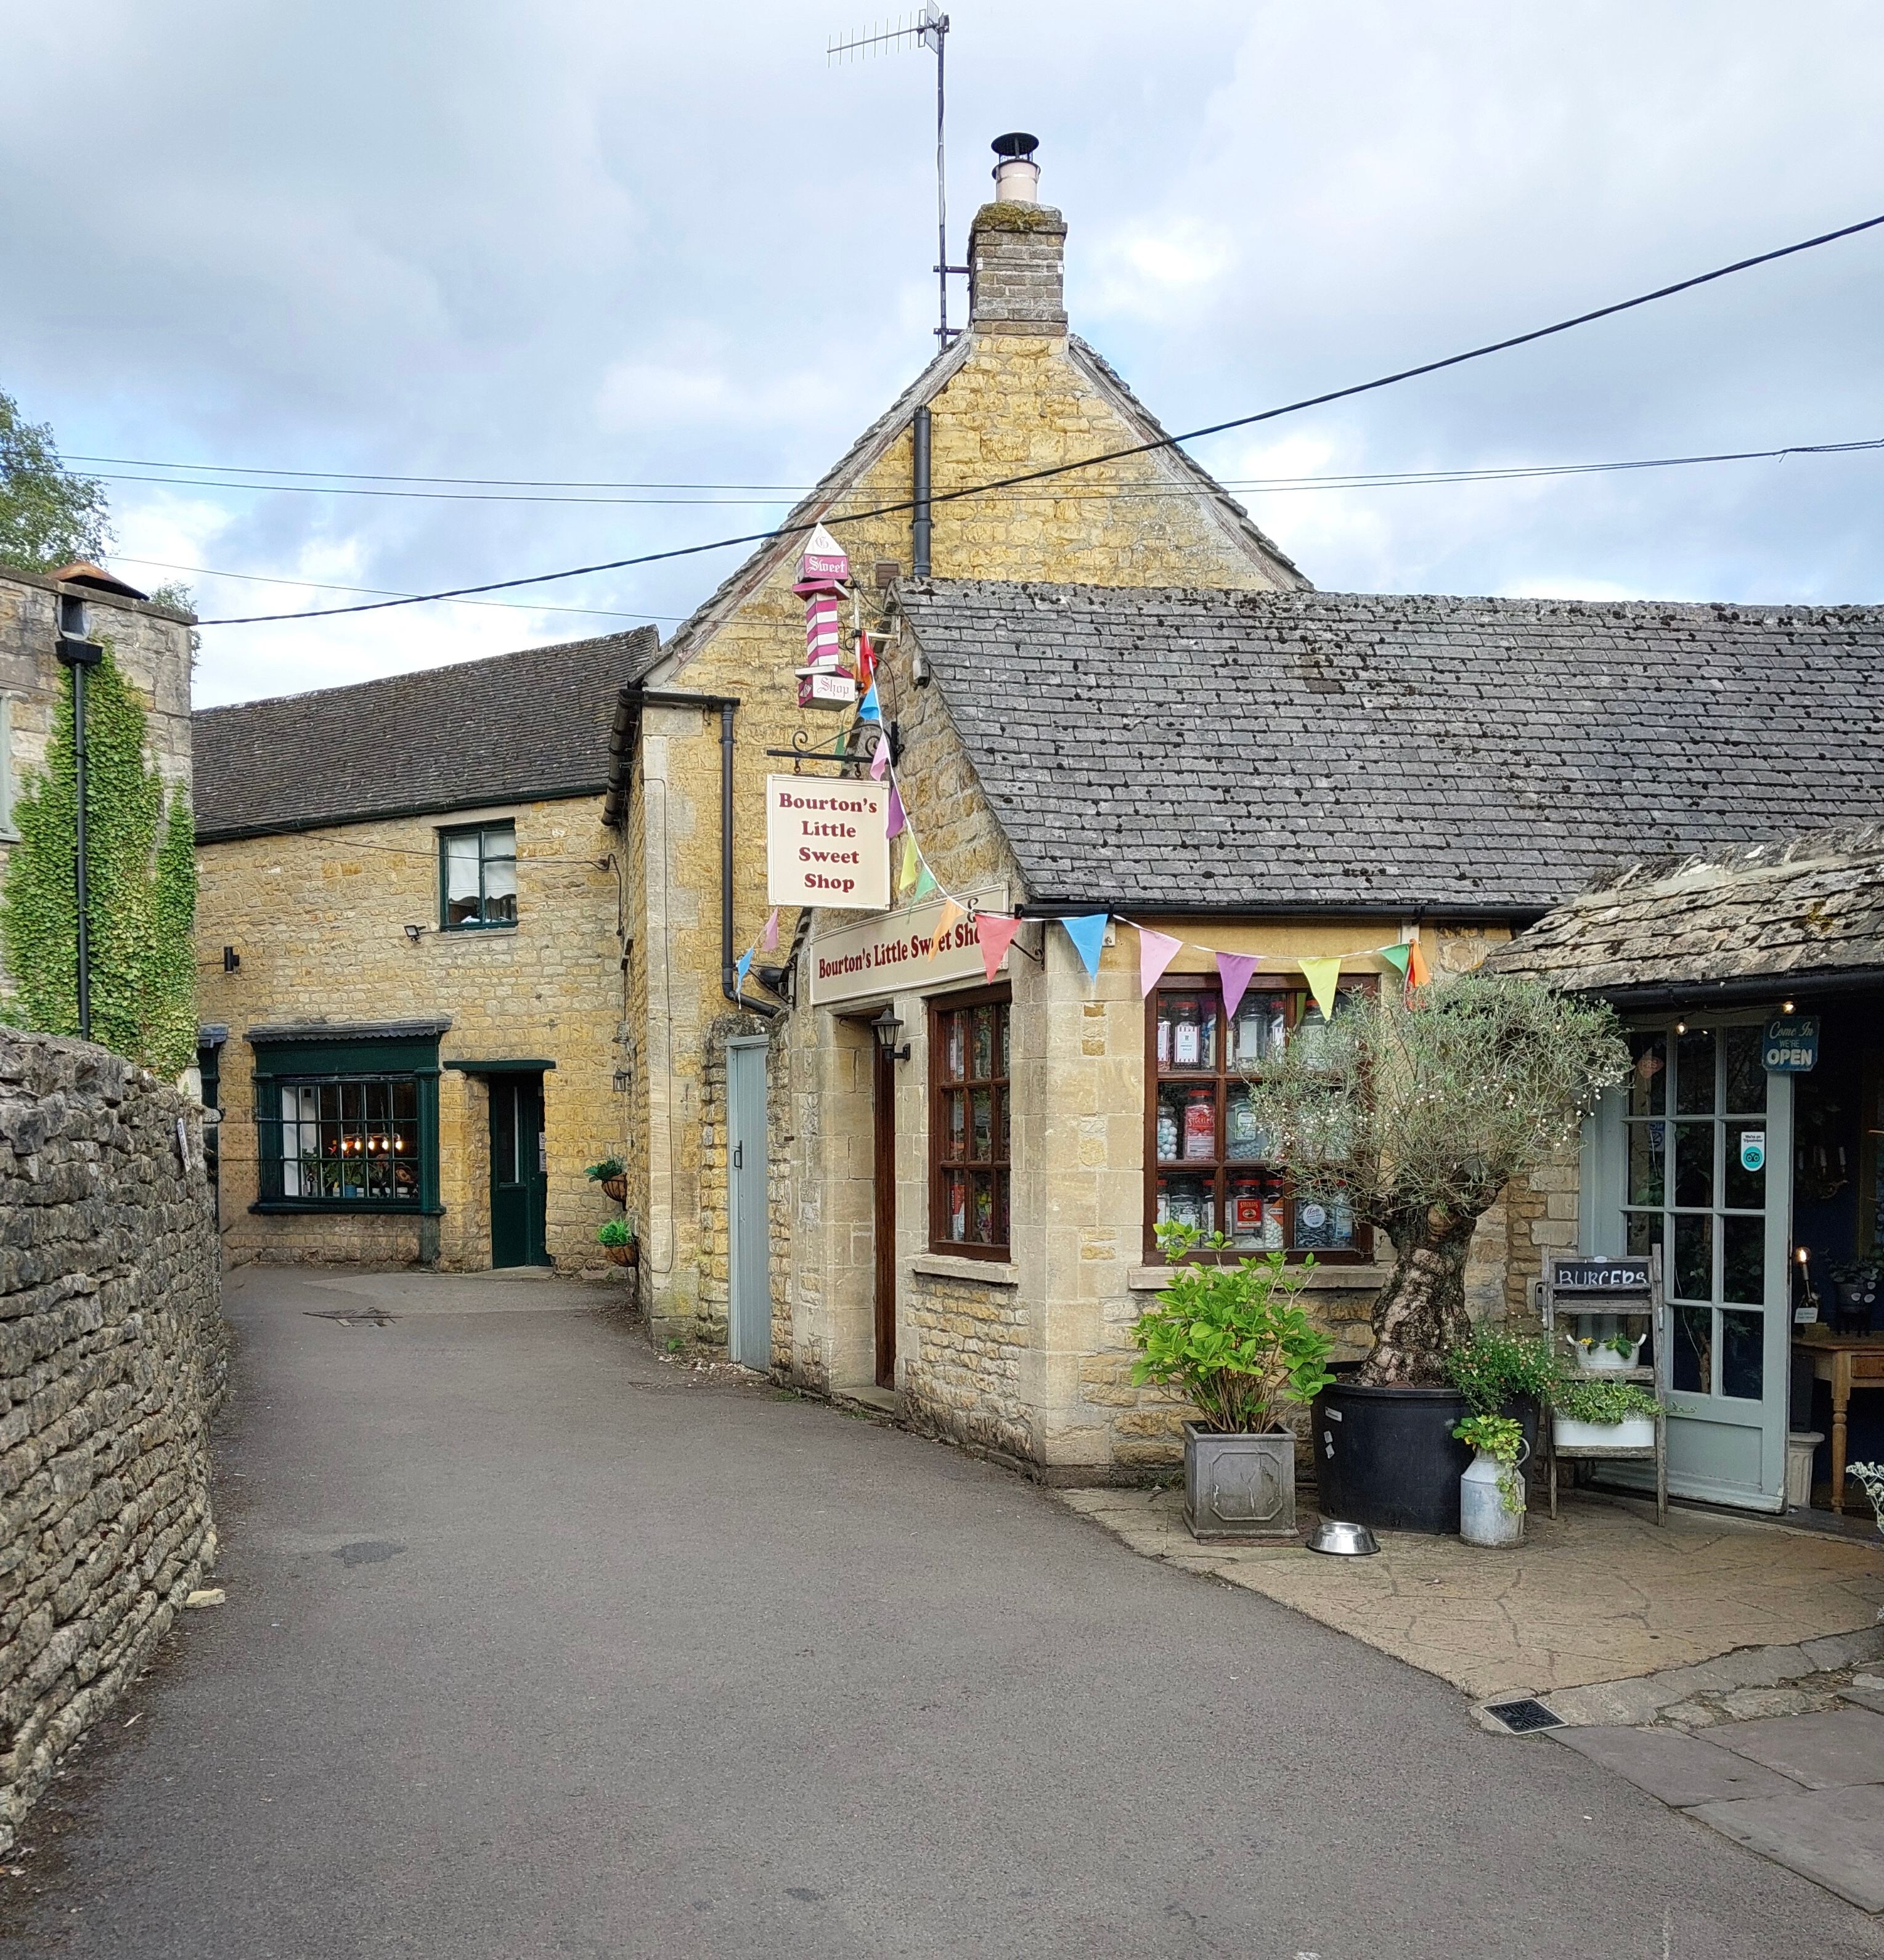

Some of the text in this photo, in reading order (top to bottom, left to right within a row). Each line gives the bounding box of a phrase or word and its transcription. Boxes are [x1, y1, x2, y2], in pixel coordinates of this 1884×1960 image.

[806, 556, 845, 573] Sweet
[817, 677, 849, 697] Shop
[779, 792, 878, 813] Bourton's
[801, 820, 857, 838] Little
[799, 847, 860, 864] Sweet
[804, 873, 855, 893] Shop
[819, 948, 871, 979] Bourton's
[874, 939, 908, 966] Little
[911, 929, 952, 958] Swet
[1769, 1021, 1814, 1039] Come In
[1767, 1048, 1813, 1065] OPEN
